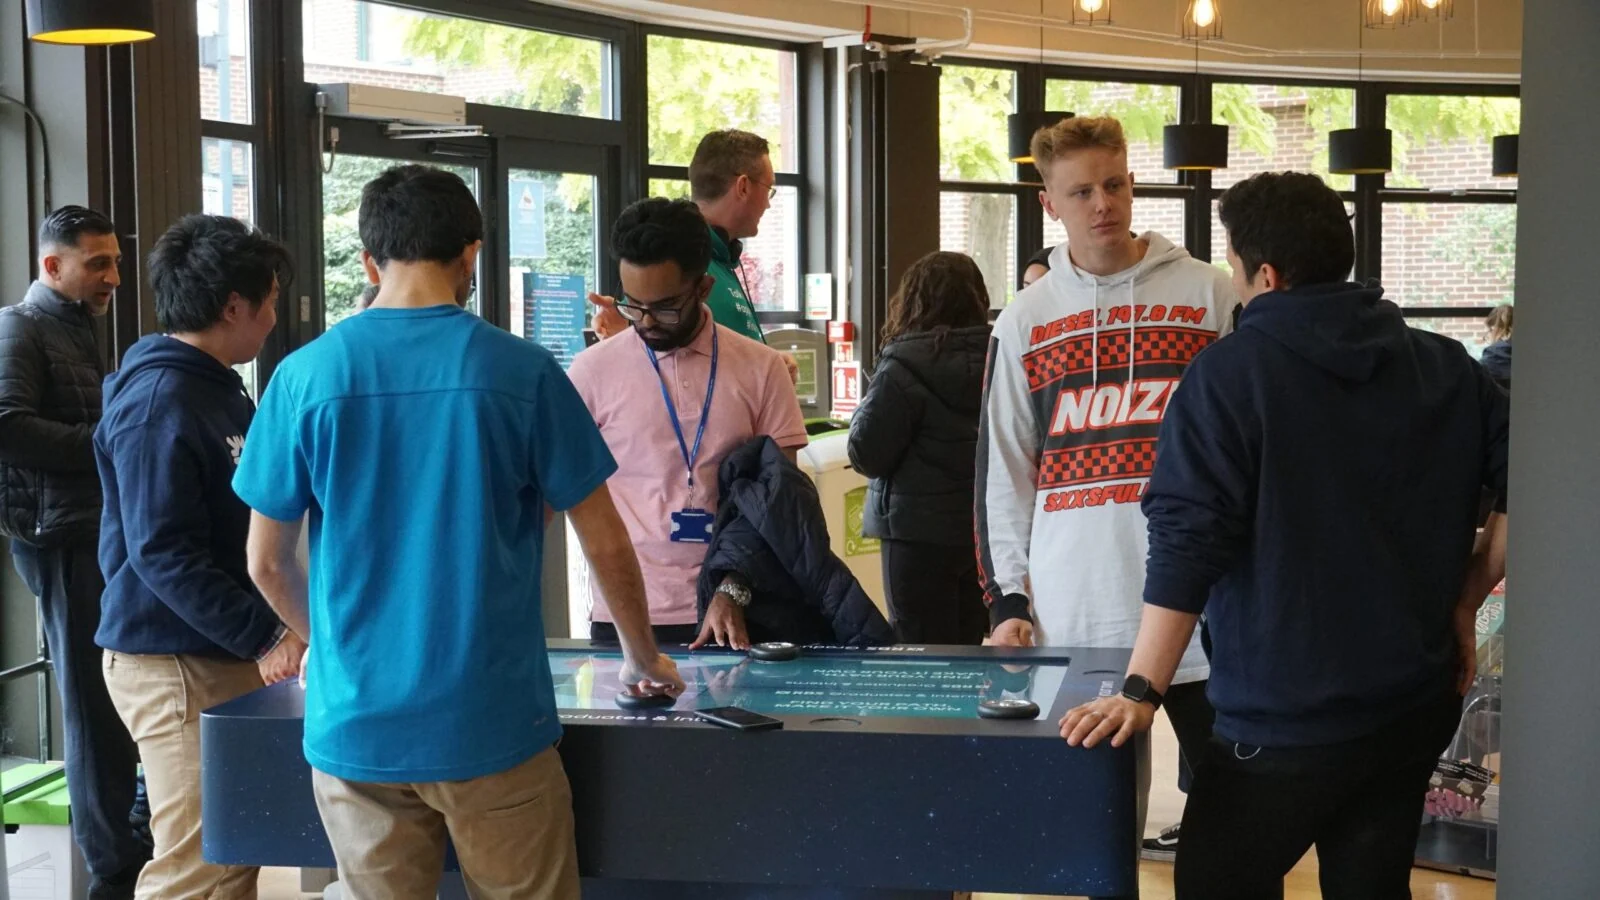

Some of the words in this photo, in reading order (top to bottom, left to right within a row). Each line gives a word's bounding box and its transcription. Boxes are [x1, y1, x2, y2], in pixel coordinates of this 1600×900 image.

[1030, 308, 1102, 345] DIESEL
[1168, 305, 1206, 324] FM
[1044, 482, 1150, 512] SXXSFUL
